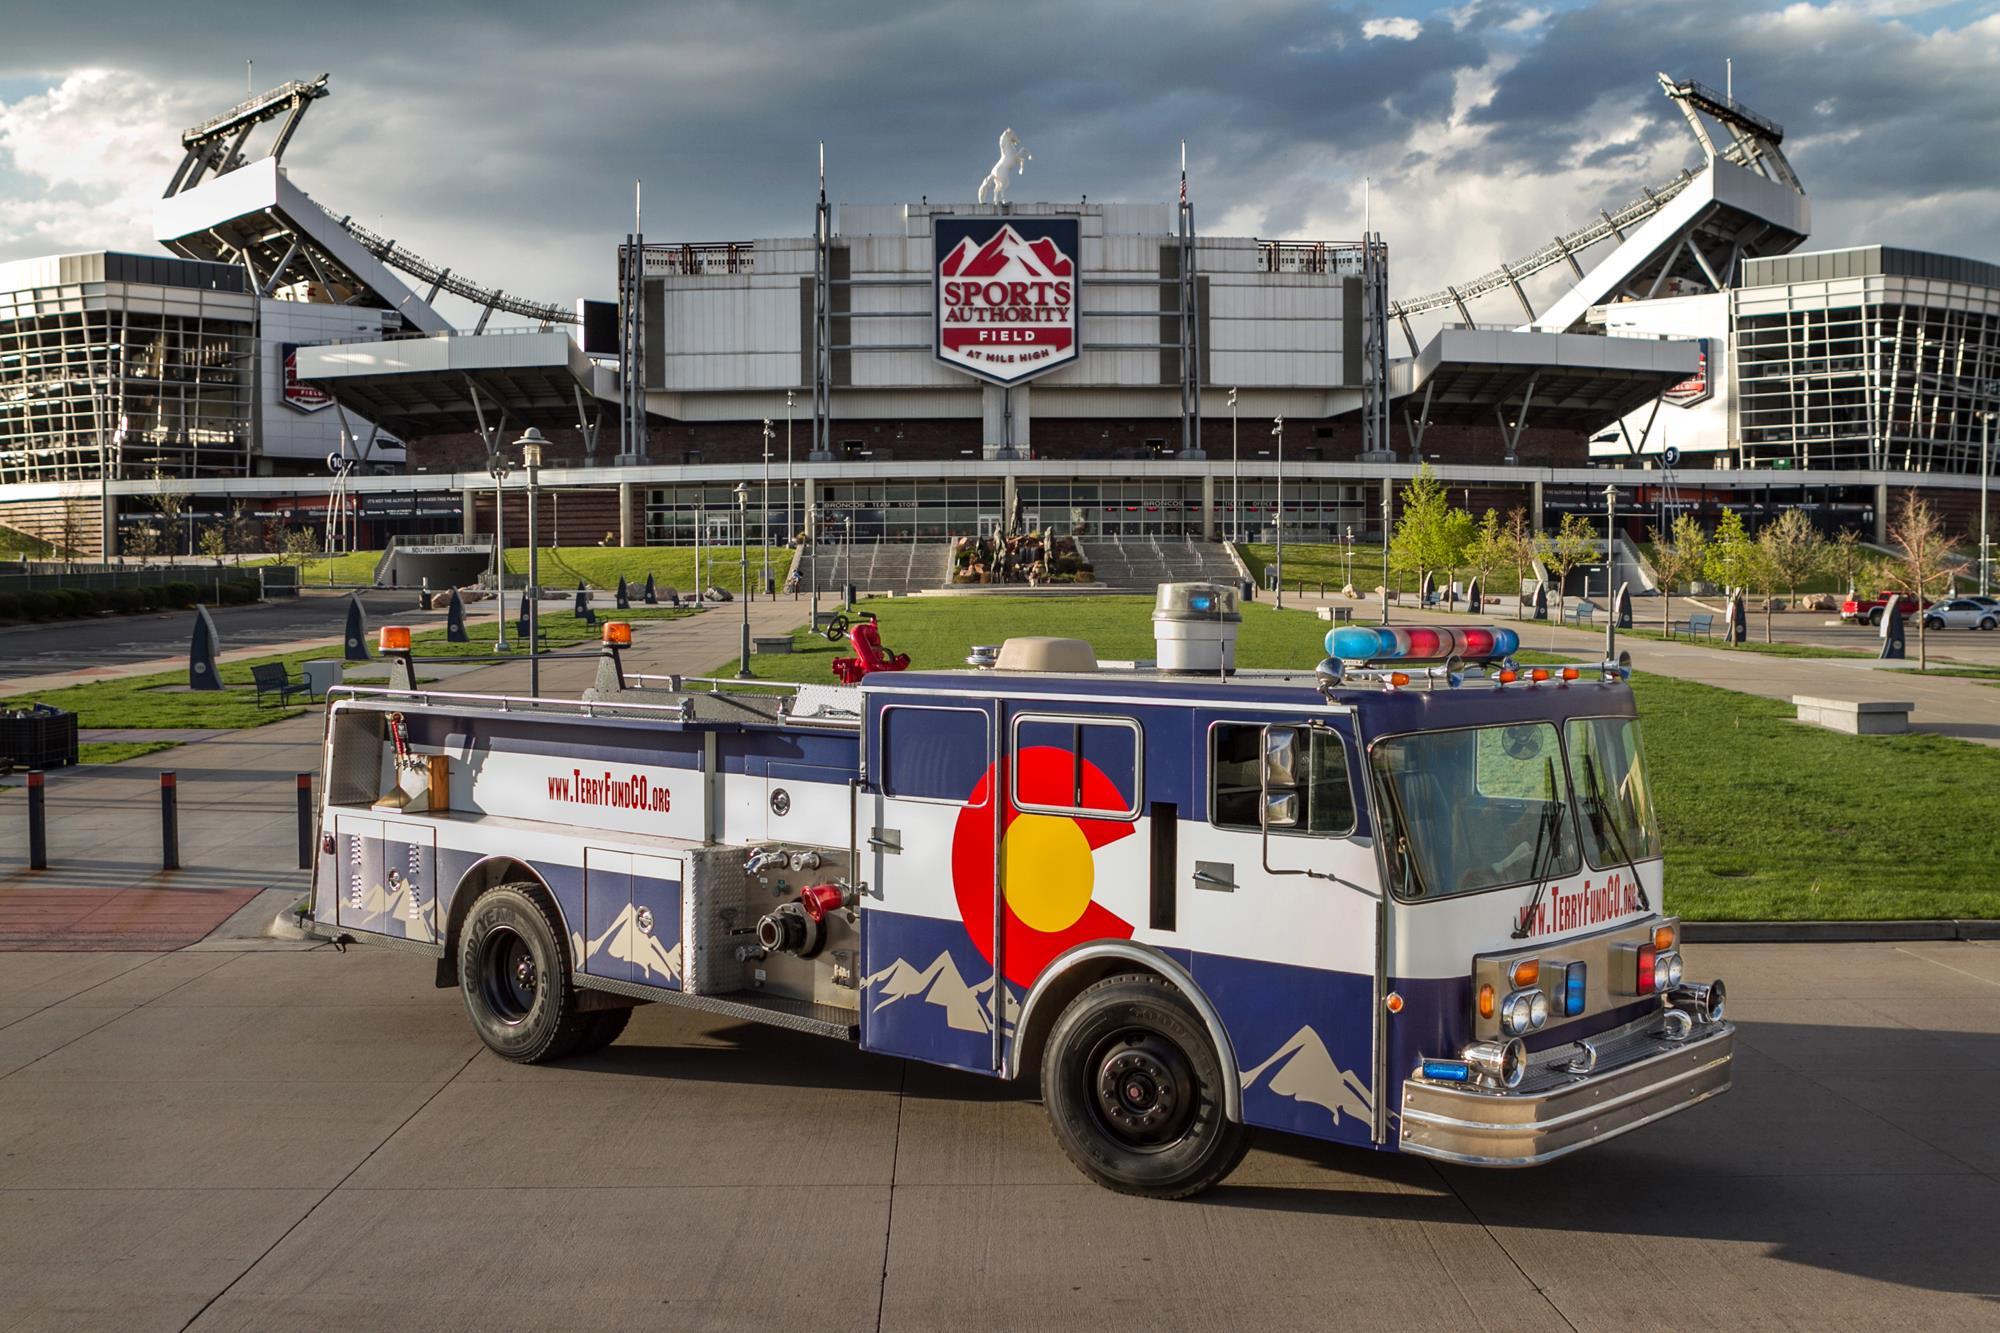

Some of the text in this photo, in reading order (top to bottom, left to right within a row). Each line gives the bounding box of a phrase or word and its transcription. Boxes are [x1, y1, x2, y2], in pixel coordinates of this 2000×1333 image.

[944, 281, 1071, 306] SPORTS
[944, 307, 1070, 322] AUTHORITY
[979, 331, 1036, 341] FIELD
[966, 349, 1050, 363] AT MILE HIGH
[1666, 451, 1673, 461] 9
[331, 457, 342, 468] 10
